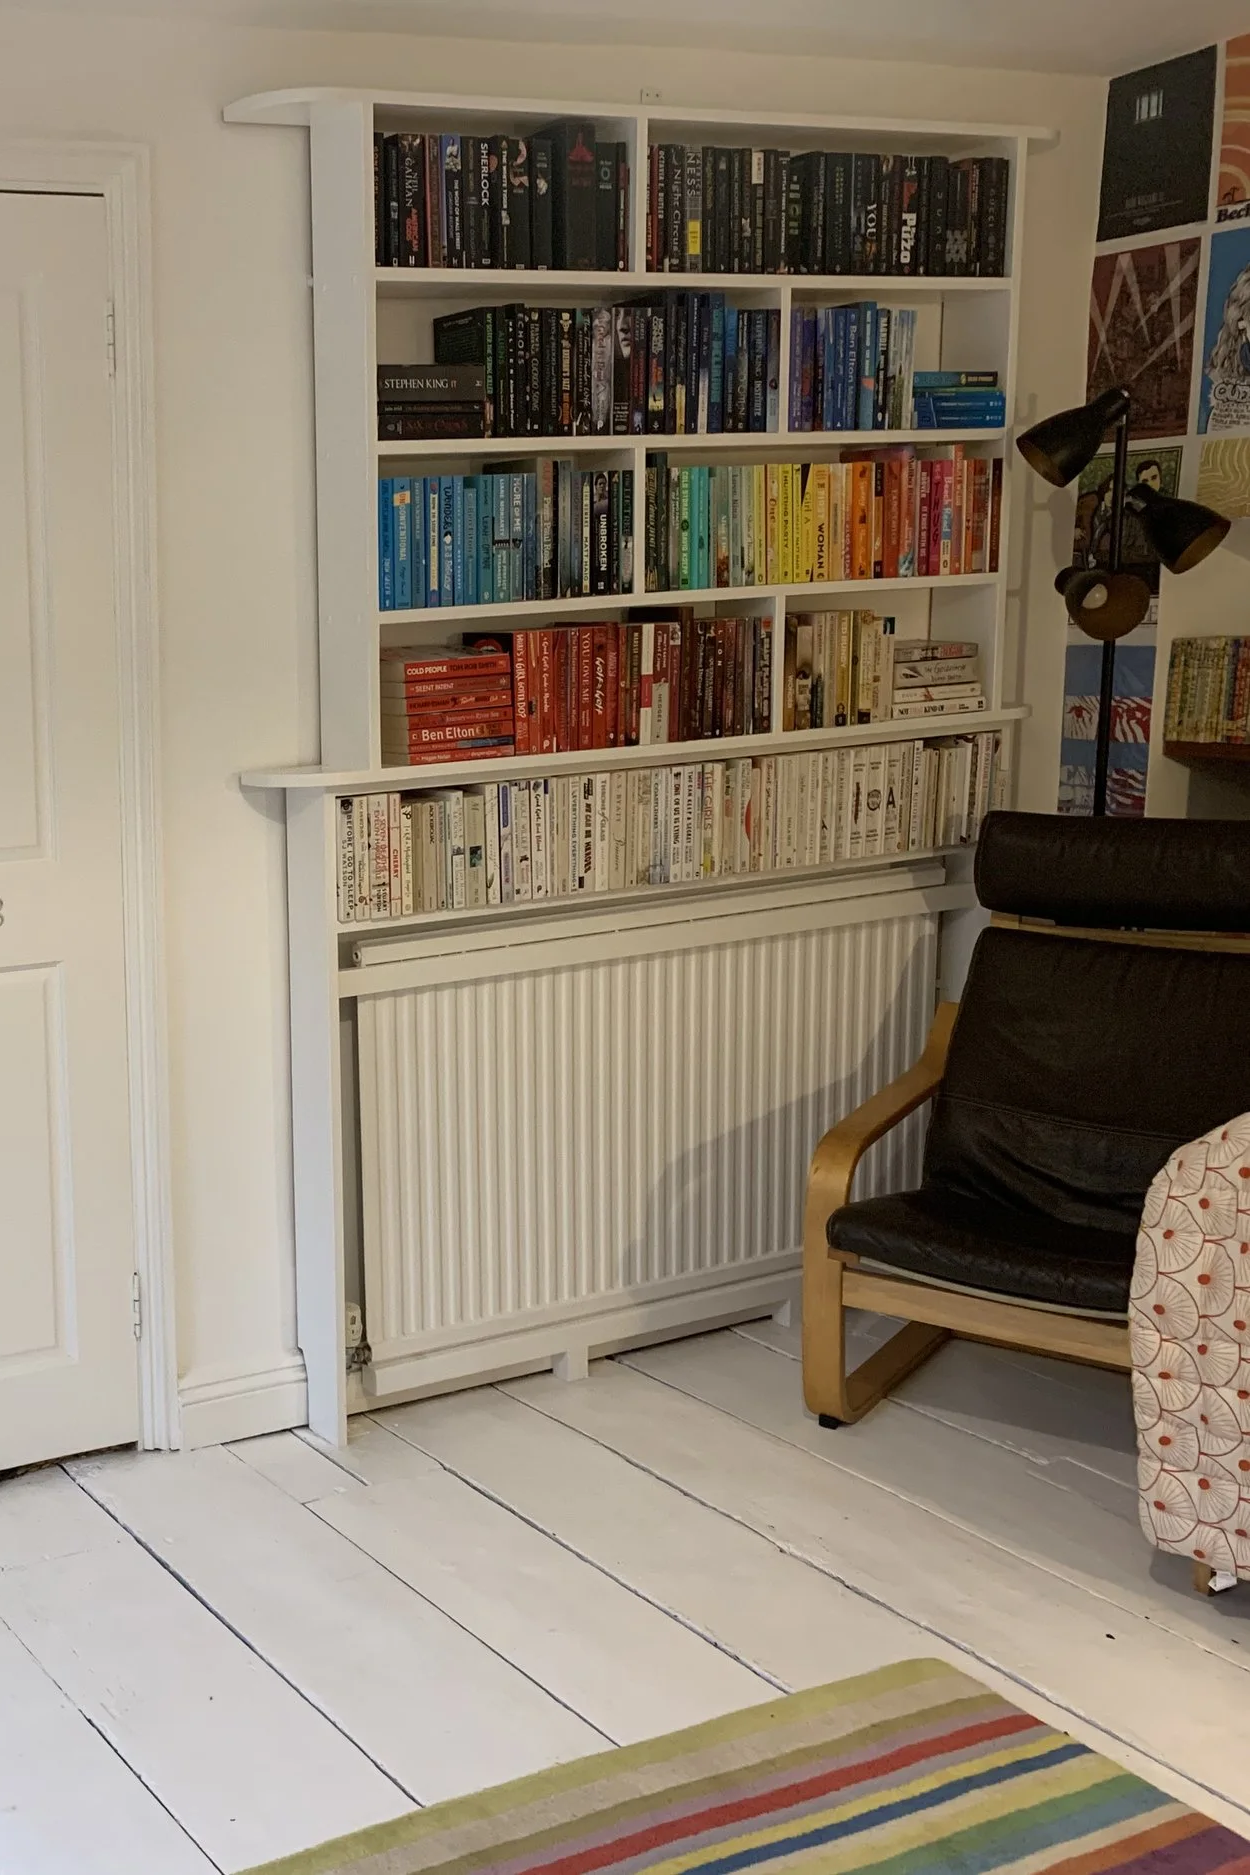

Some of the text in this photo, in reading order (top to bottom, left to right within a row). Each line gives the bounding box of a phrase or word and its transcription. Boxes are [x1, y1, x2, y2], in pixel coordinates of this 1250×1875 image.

[405, 157, 414, 207] GAIMAN
[480, 143, 490, 206] SHERLOCK
[686, 152, 696, 197] NESS
[671, 168, 681, 252] Night Circus
[866, 202, 877, 240] YOU
[900, 212, 917, 264] Puzo
[517, 313, 525, 366] ECHOES
[755, 314, 763, 353] STEPHEN
[754, 354, 762, 377] KING
[848, 325, 857, 383] Ben Elton
[384, 378, 458, 390] STEPHEN KING IT
[531, 358, 540, 412] CUCKOO SONG
[580, 387, 591, 408] Wife
[907, 455, 915, 486] Malibu
[443, 486, 452, 530] WONDER
[512, 477, 522, 533] MORE OF ME
[769, 498, 777, 524] One
[942, 476, 952, 532] Beach Read
[543, 522, 551, 542] Paul
[599, 514, 607, 571] UNBROKEN
[817, 522, 825, 569] WOMAN
[543, 543, 551, 568] Read
[840, 615, 848, 668] TED BUNDY
[406, 668, 424, 676] COLD
[424, 665, 448, 674] PEOPLE
[478, 661, 496, 669] SMITH
[515, 662, 526, 681] GIRL
[581, 632, 591, 704] YOU LOVE ME
[415, 682, 455, 694] SILENT PATIENT
[516, 681, 526, 701] GOTTA
[516, 701, 527, 719] DO?
[898, 708, 909, 716] NOT
[421, 726, 475, 742] Ben Elton
[673, 797, 680, 807] OF
[673, 807, 680, 816] US
[703, 769, 713, 831] THE GIRLS
[584, 814, 592, 828] CAN
[346, 856, 353, 868] GO
[584, 841, 592, 874] HEROES
[347, 870, 353, 882] TO
